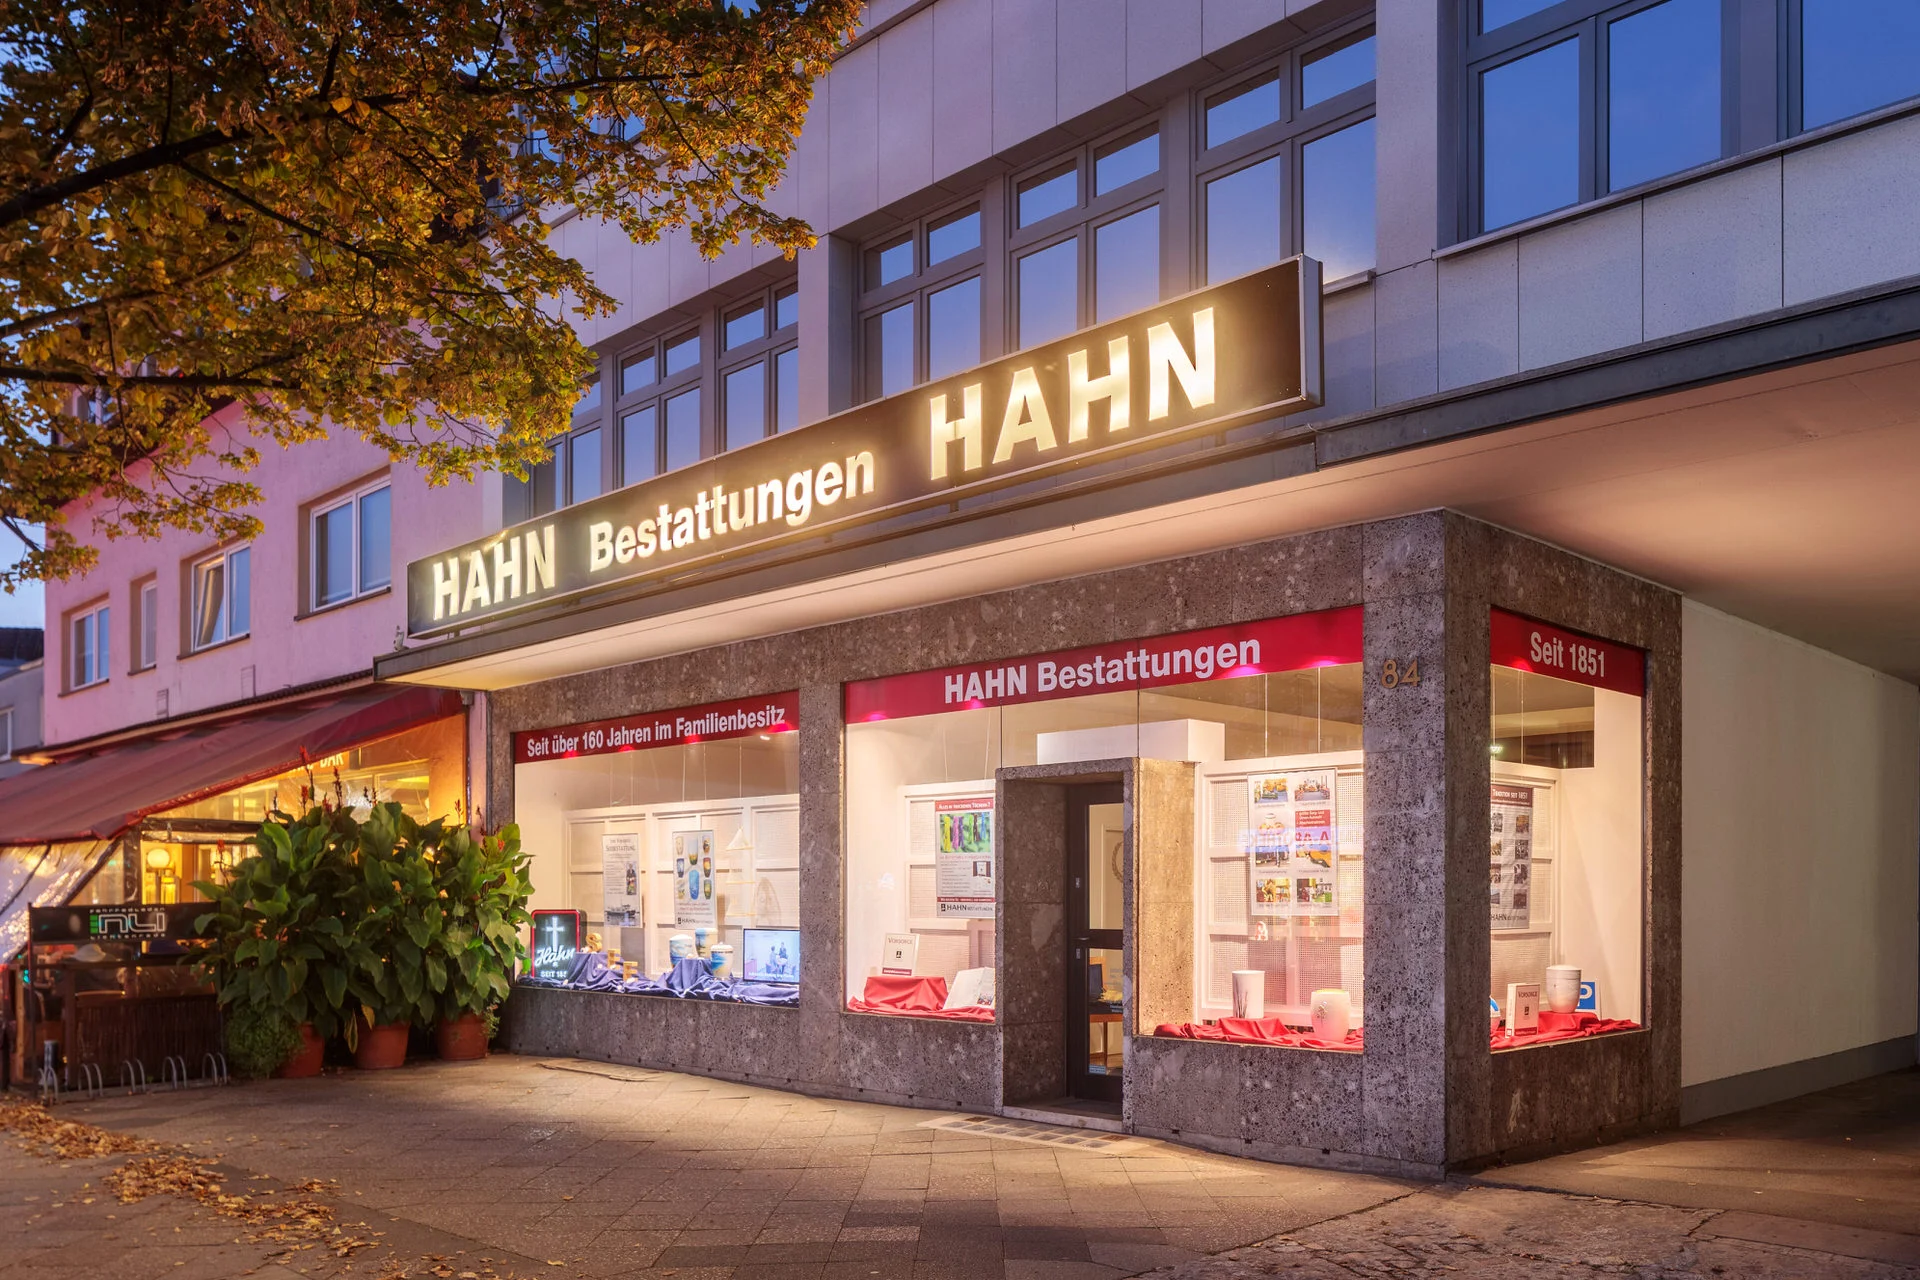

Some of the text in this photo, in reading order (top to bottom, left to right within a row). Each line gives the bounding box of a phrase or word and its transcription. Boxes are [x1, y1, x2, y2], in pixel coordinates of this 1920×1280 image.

[433, 307, 1215, 621] HAHN Bestattungen HAHN
[945, 638, 1261, 703] HAHN Bestattungen
[1380, 658, 1420, 689] 84
[1530, 632, 1605, 677] Seit 1851
[527, 705, 786, 757] Seit über 160 Jahren im Familienbesitz
[946, 903, 967, 911] HAHN
[534, 945, 576, 967] Hahn
[540, 970, 555, 978] SEIT
